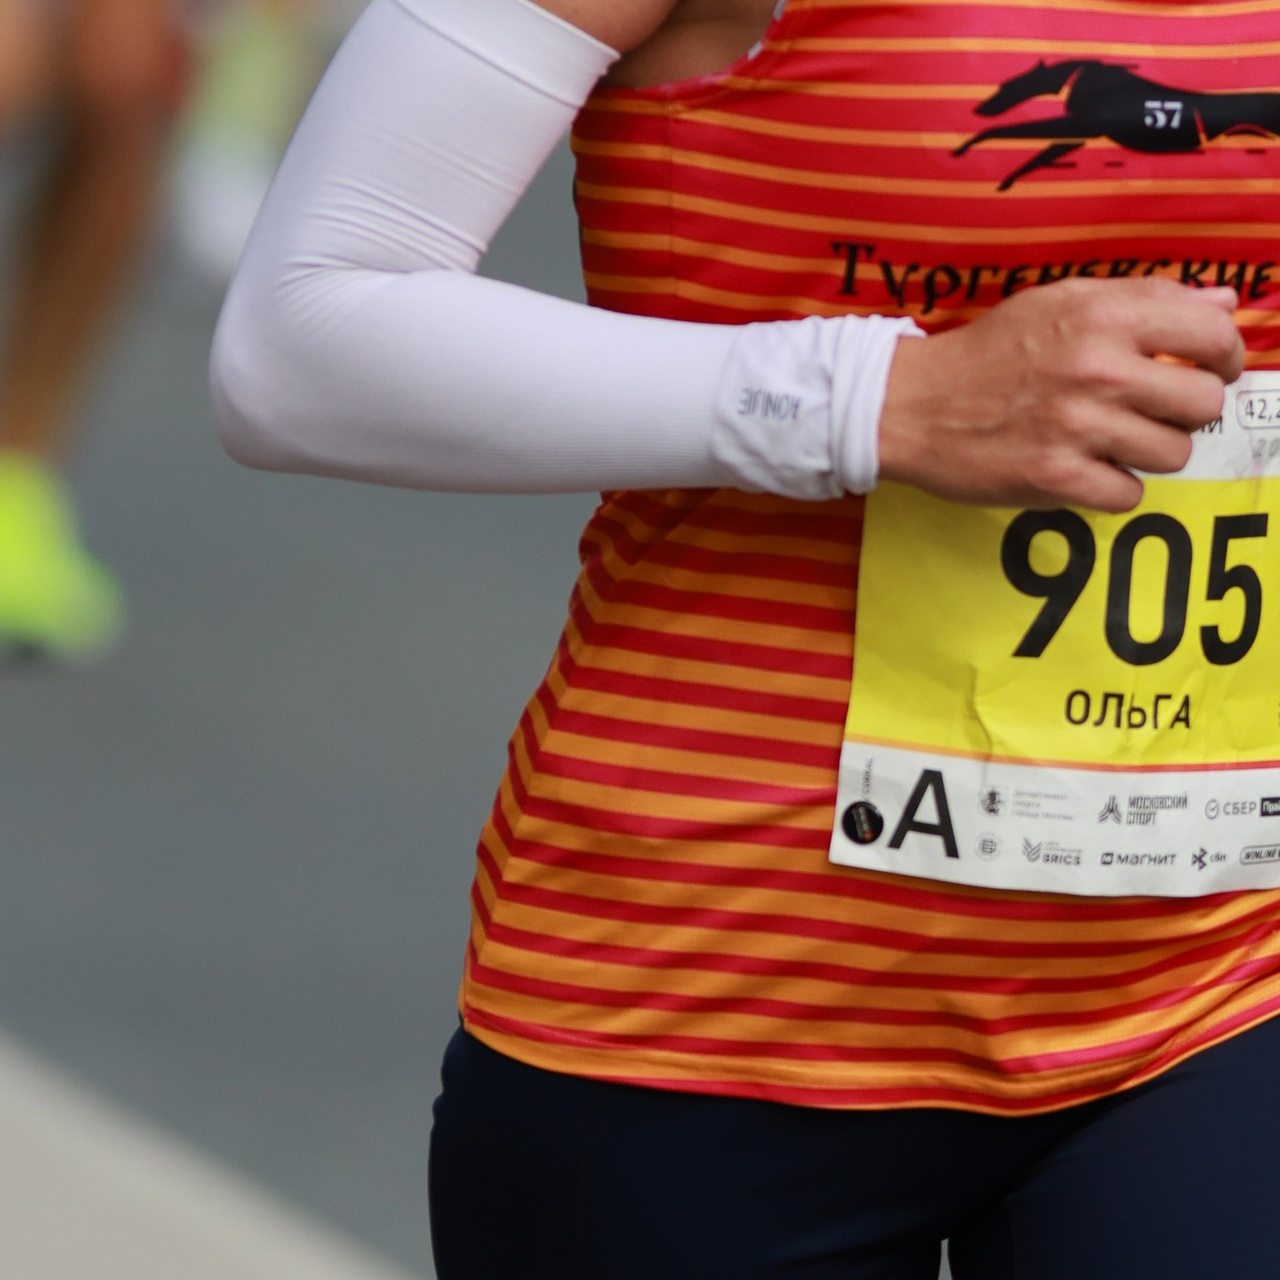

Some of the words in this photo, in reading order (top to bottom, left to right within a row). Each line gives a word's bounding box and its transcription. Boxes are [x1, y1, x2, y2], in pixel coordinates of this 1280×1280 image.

[1144, 101, 1183, 129] 57
[1001, 508, 1269, 665] 905
[1065, 690, 1191, 730] ОЛЬГА
[1223, 801, 1257, 815] СБЕР
